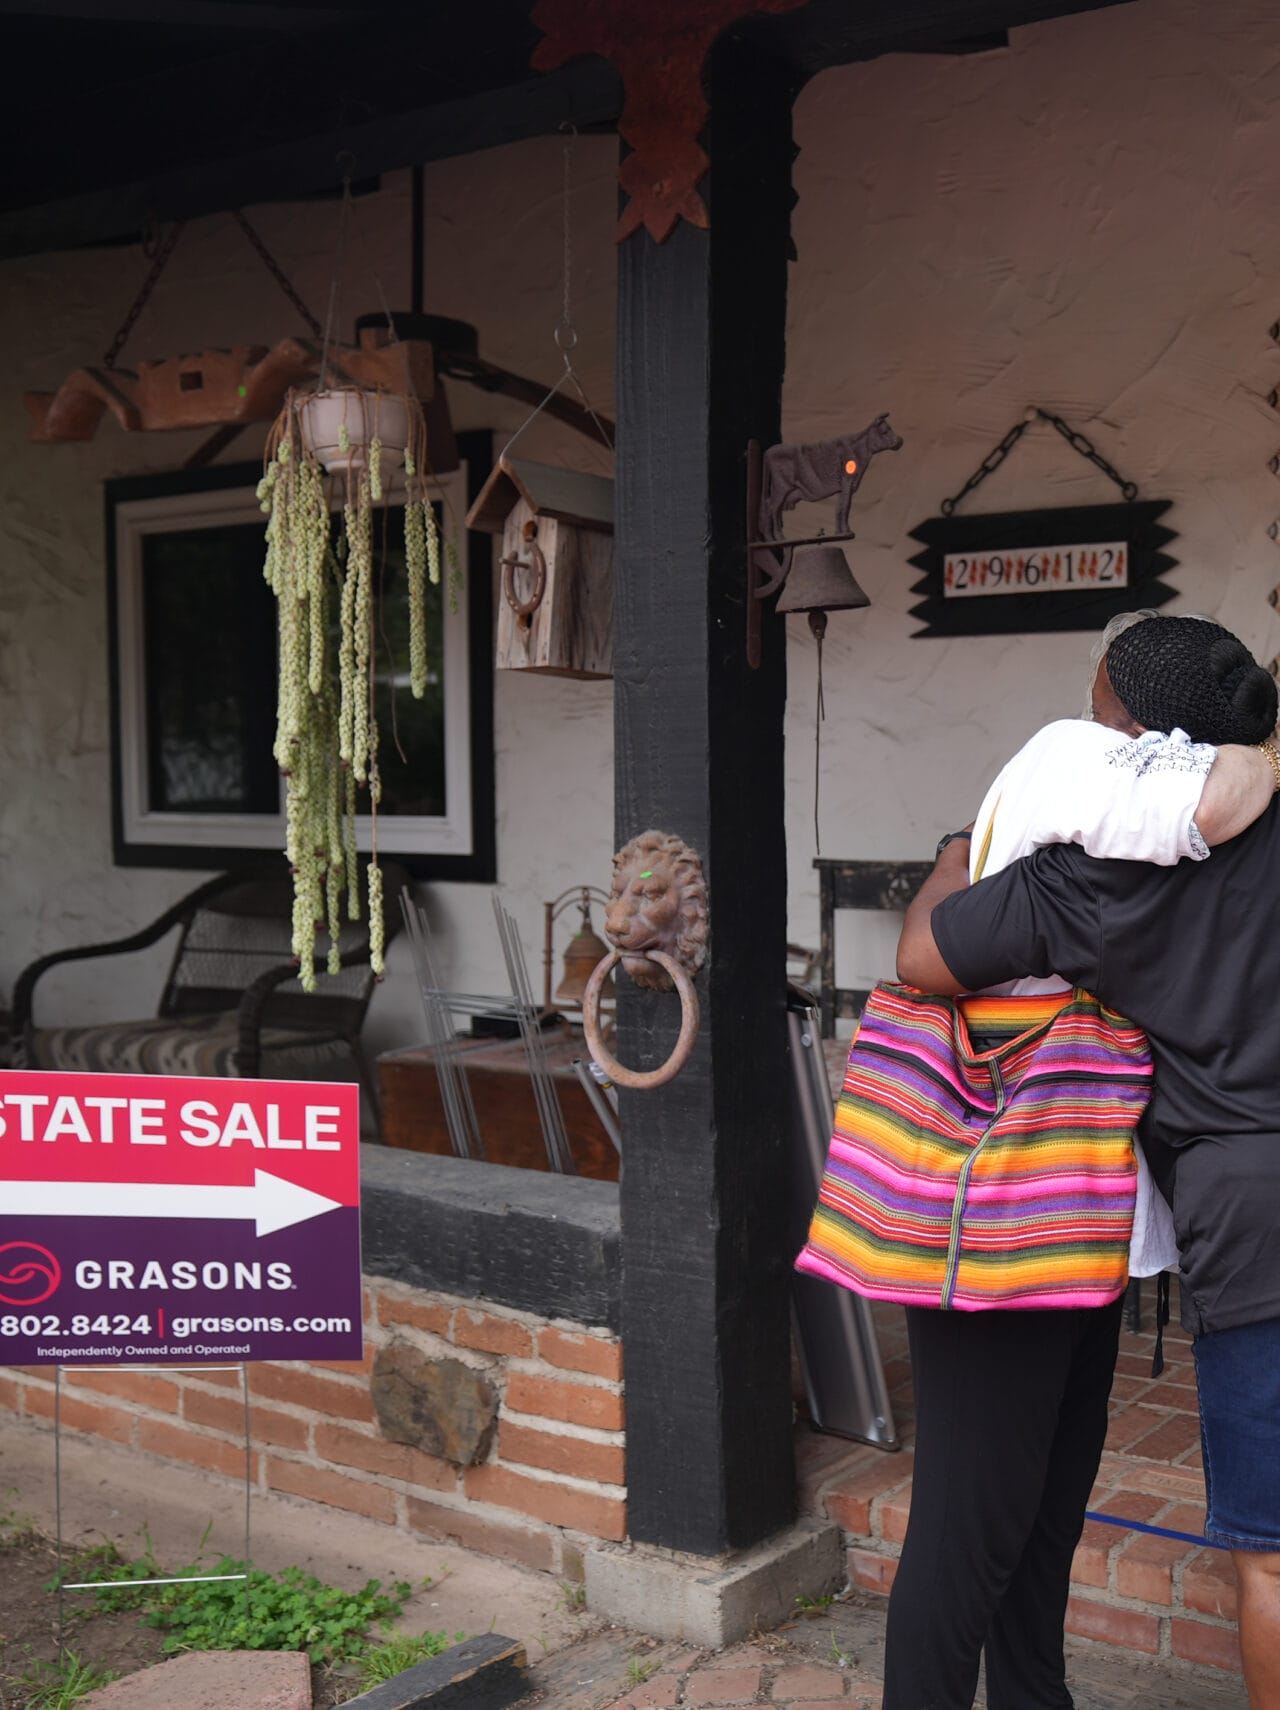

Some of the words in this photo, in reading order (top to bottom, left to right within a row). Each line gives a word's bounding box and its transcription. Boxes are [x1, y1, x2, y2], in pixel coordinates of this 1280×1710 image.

[0, 1094, 168, 1146] TATE
[179, 1100, 342, 1151] SALE
[74, 1259, 294, 1291] GRASONS
[0, 1314, 153, 1337] 802.8424
[171, 1316, 352, 1339] grasons.com
[37, 1346, 123, 1358] Independently
[125, 1345, 169, 1356] Owned
[170, 1344, 193, 1355] and
[194, 1343, 251, 1356] Operated
